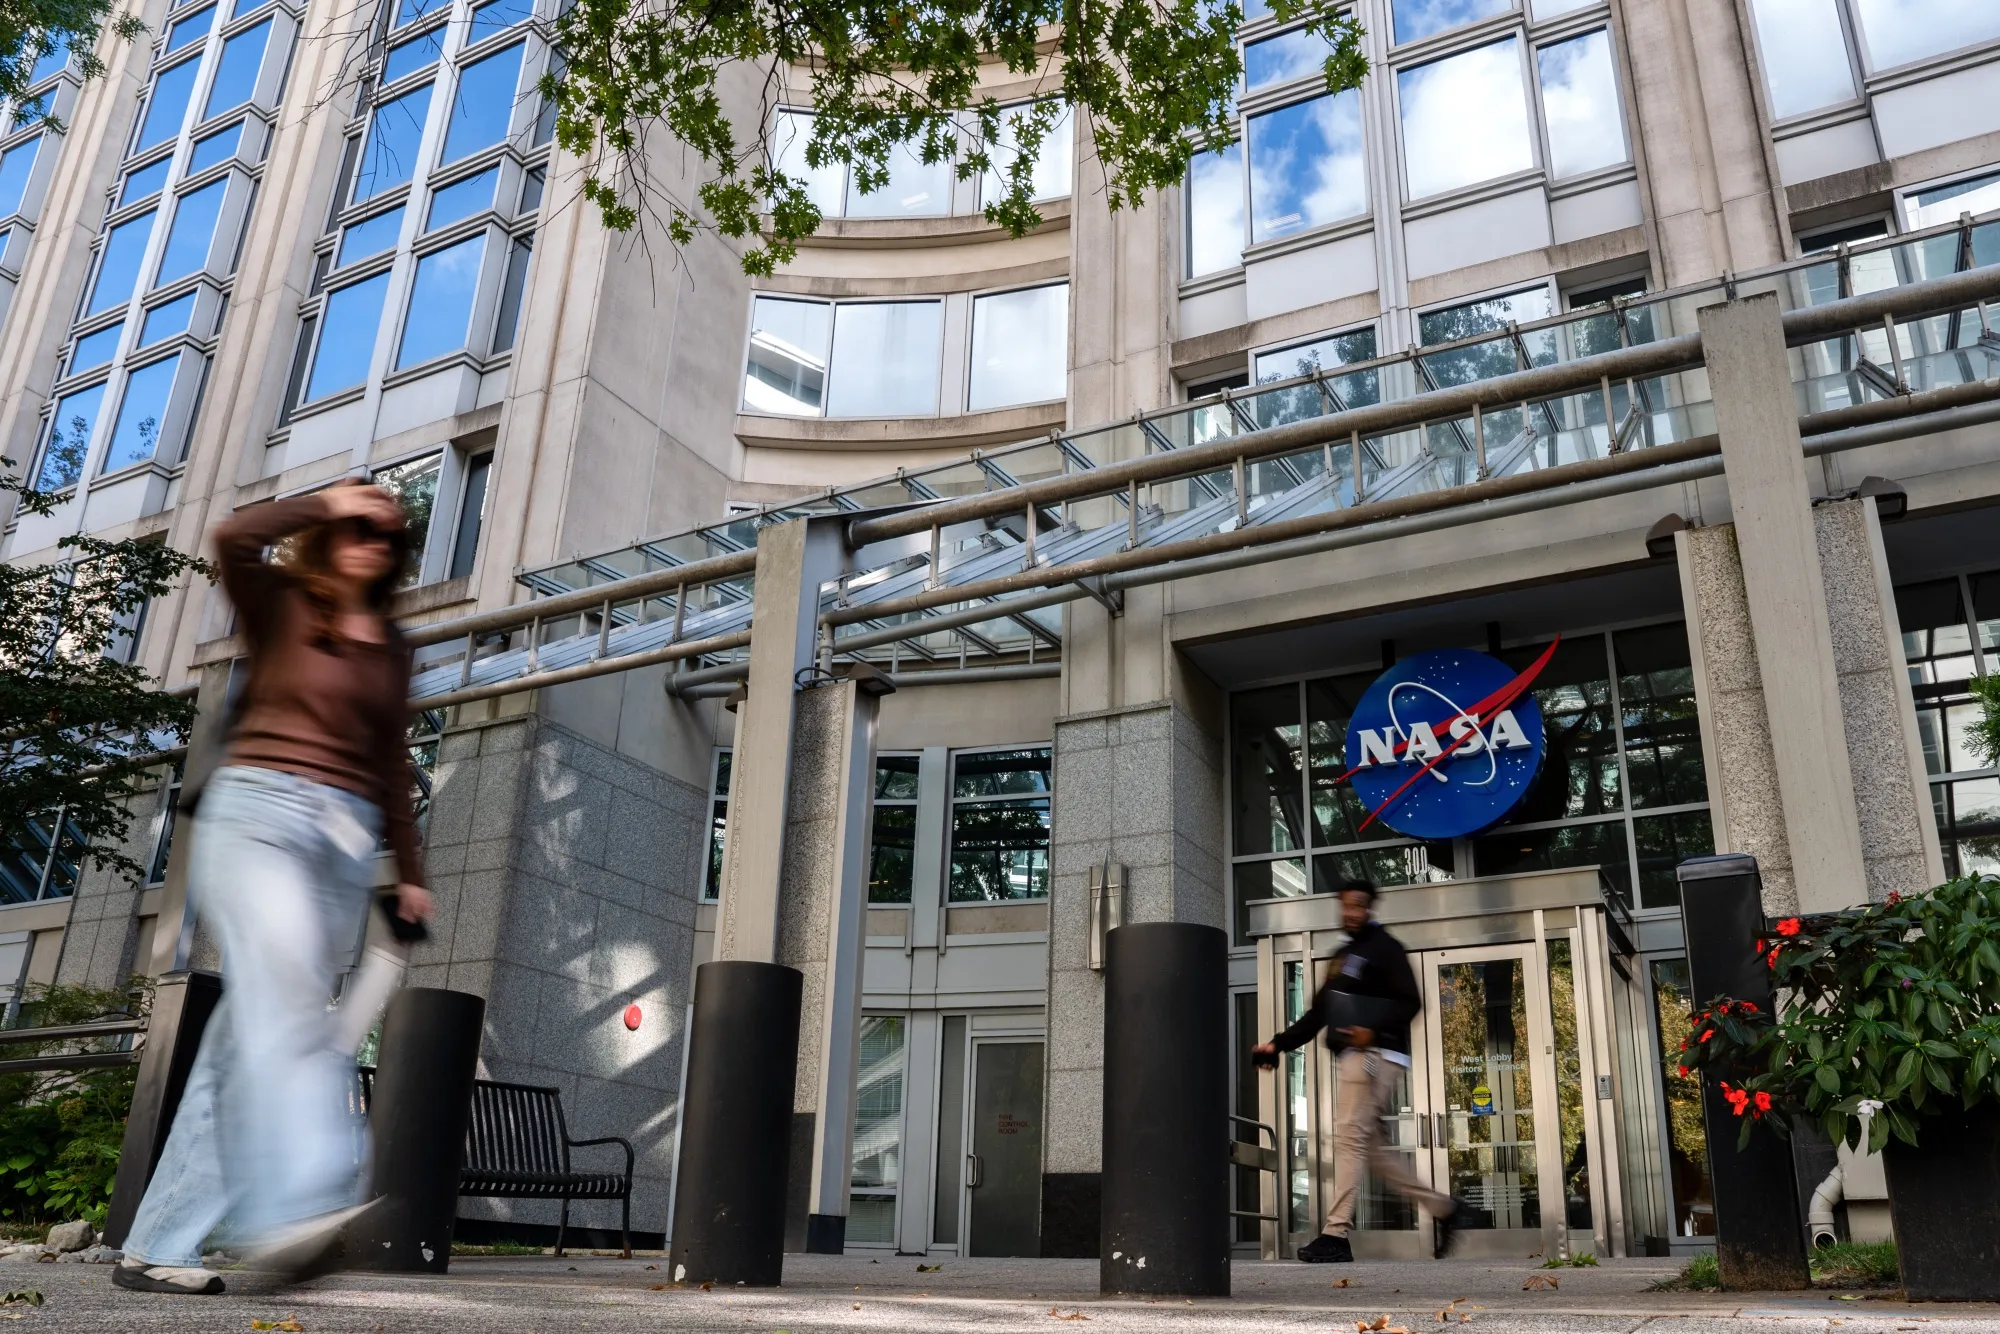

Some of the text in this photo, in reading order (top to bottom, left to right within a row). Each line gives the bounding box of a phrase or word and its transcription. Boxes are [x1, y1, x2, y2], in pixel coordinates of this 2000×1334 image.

[1357, 710, 1532, 768] NASA
[1404, 846, 1427, 875] 300
[1461, 1053, 1512, 1063] West Lobby
[1487, 1063, 1525, 1071] Entrance
